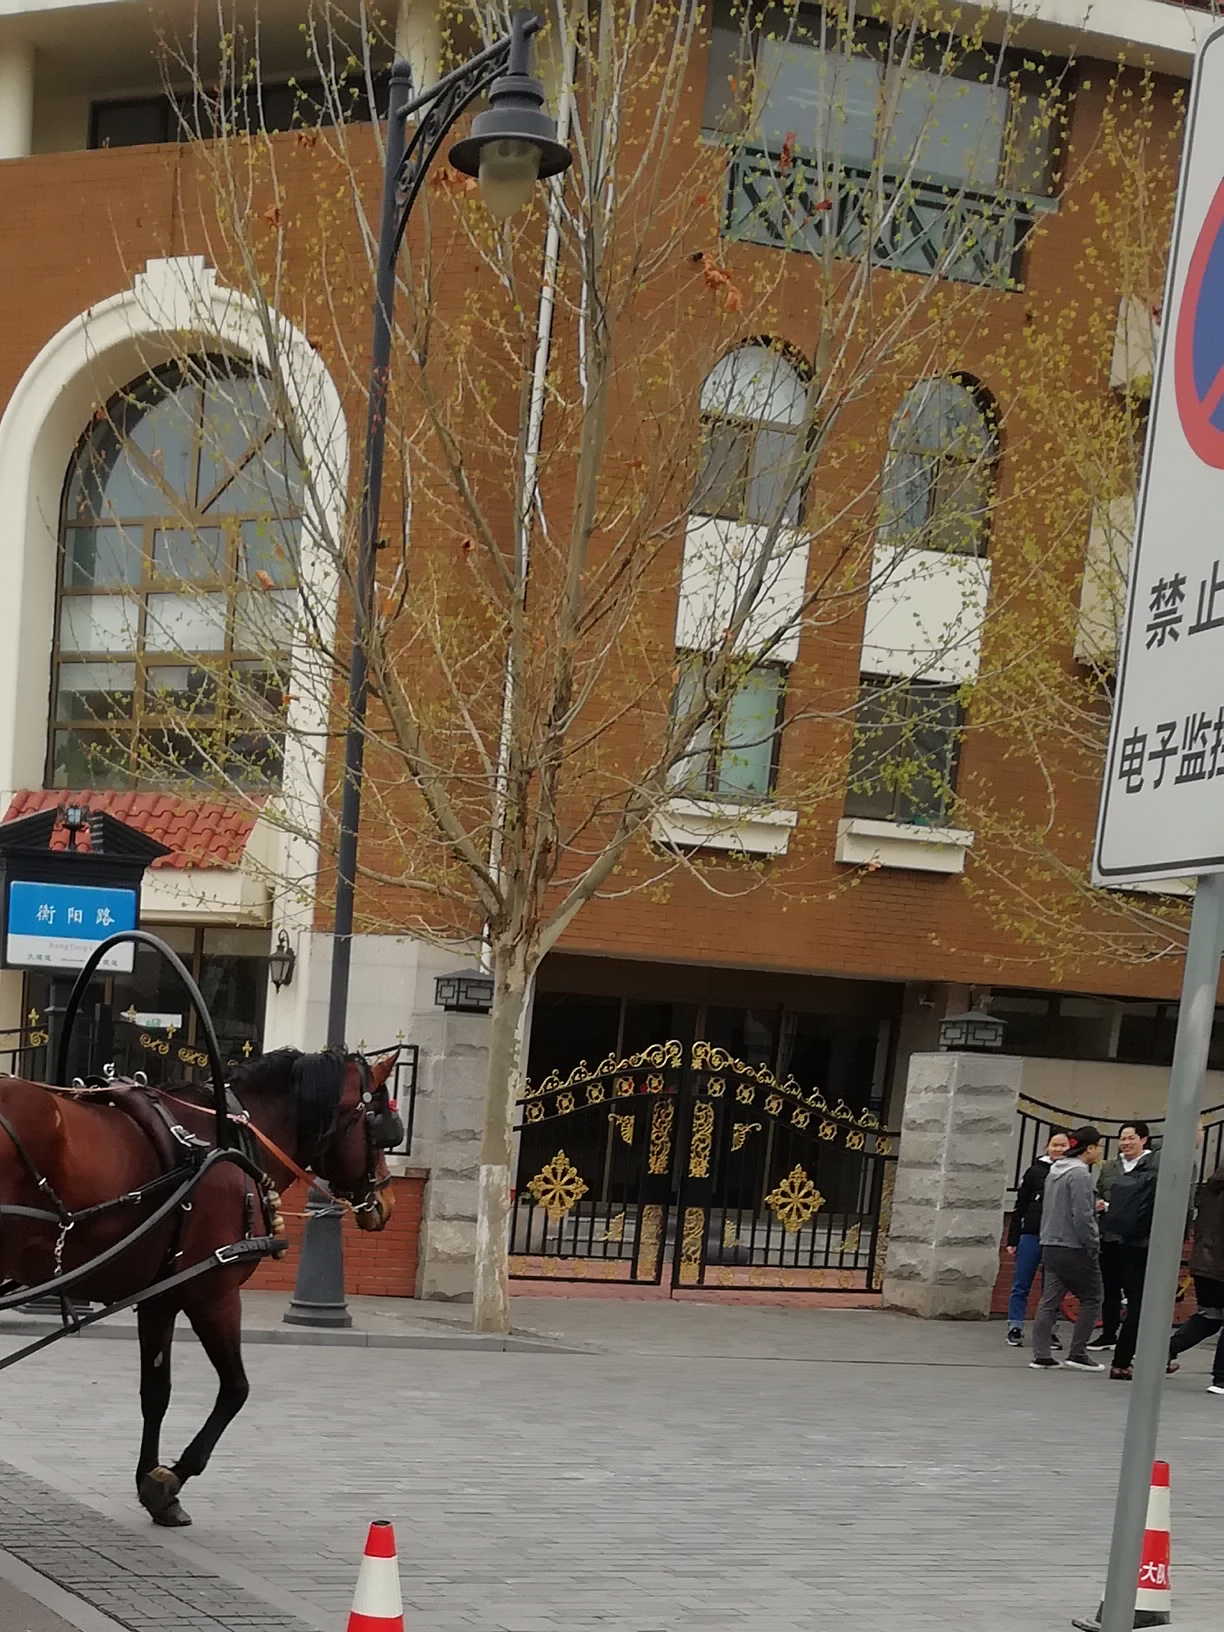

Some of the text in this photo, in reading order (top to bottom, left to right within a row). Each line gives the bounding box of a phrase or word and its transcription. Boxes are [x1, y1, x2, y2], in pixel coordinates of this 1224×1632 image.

[1145, 560, 1224, 650] 禁止
[35, 903, 116, 927] 衡阳路
[1139, 1561, 1167, 1586] 大队
